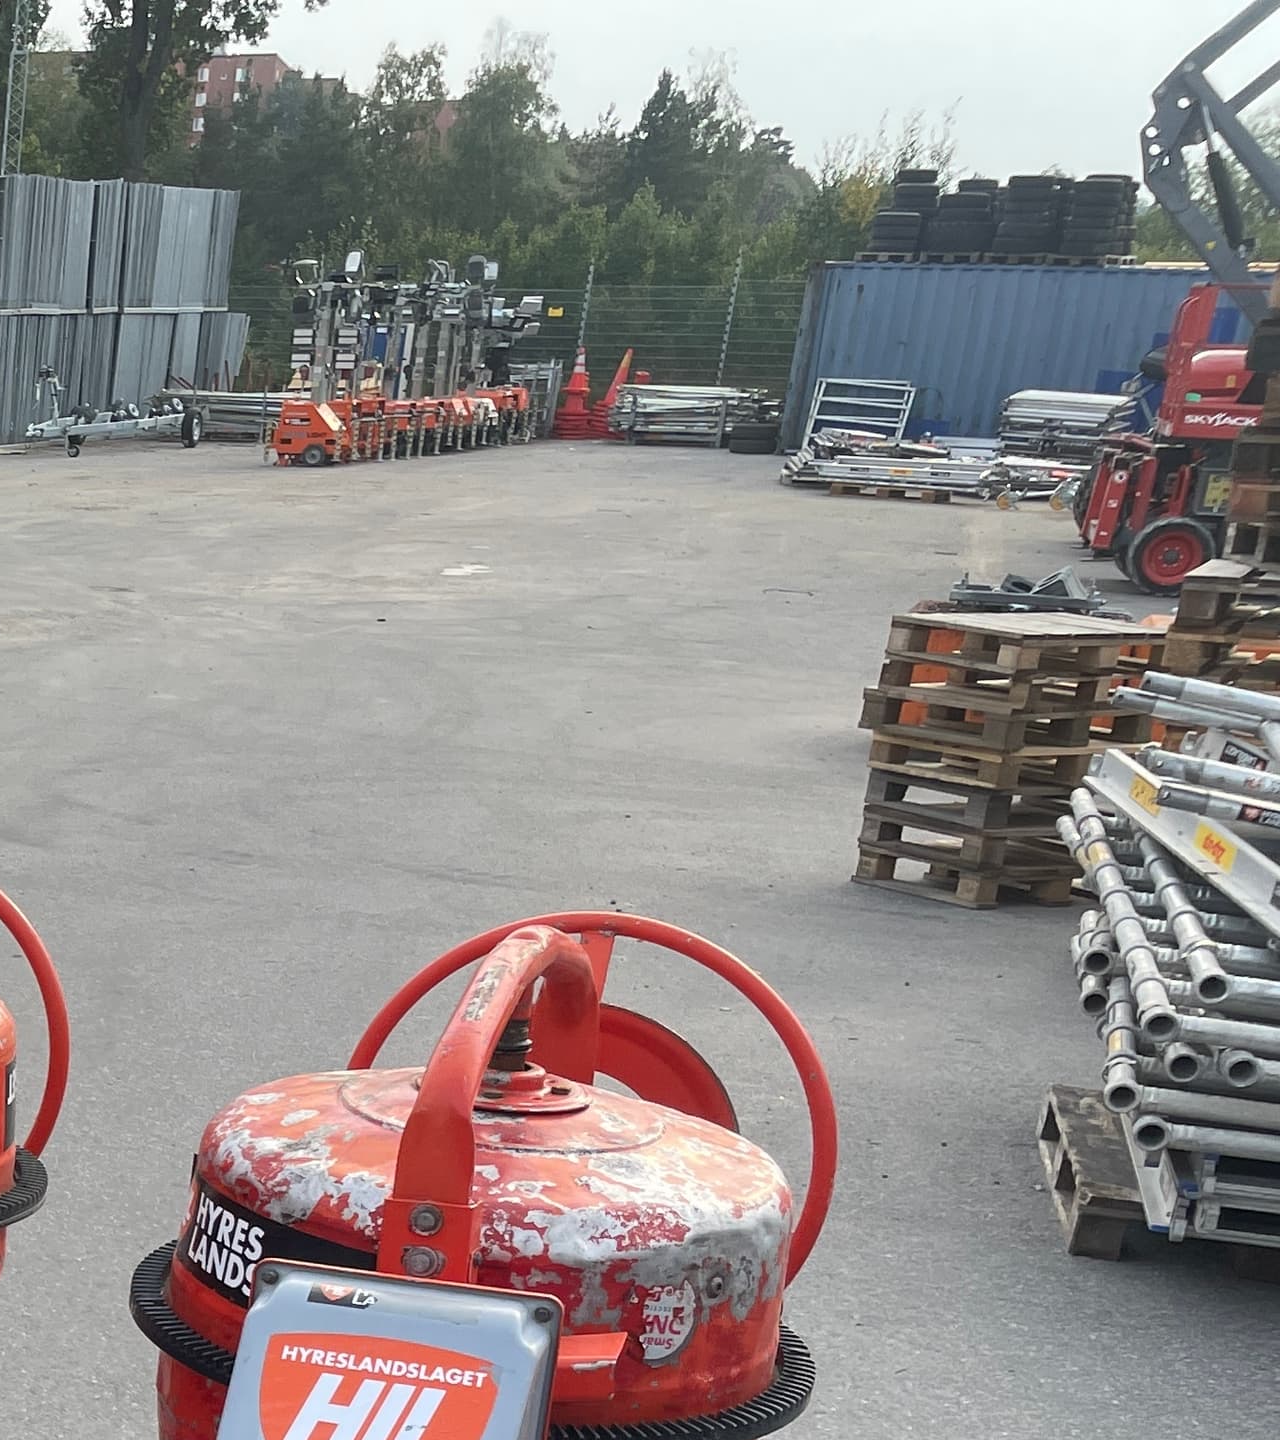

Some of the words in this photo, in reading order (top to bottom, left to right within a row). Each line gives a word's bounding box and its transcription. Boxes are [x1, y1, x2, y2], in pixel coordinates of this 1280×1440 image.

[1183, 412, 1258, 428] SKYJACK
[196, 1191, 265, 1262] HYRES
[281, 1345, 488, 1388] HYRESLANDSLAGET
